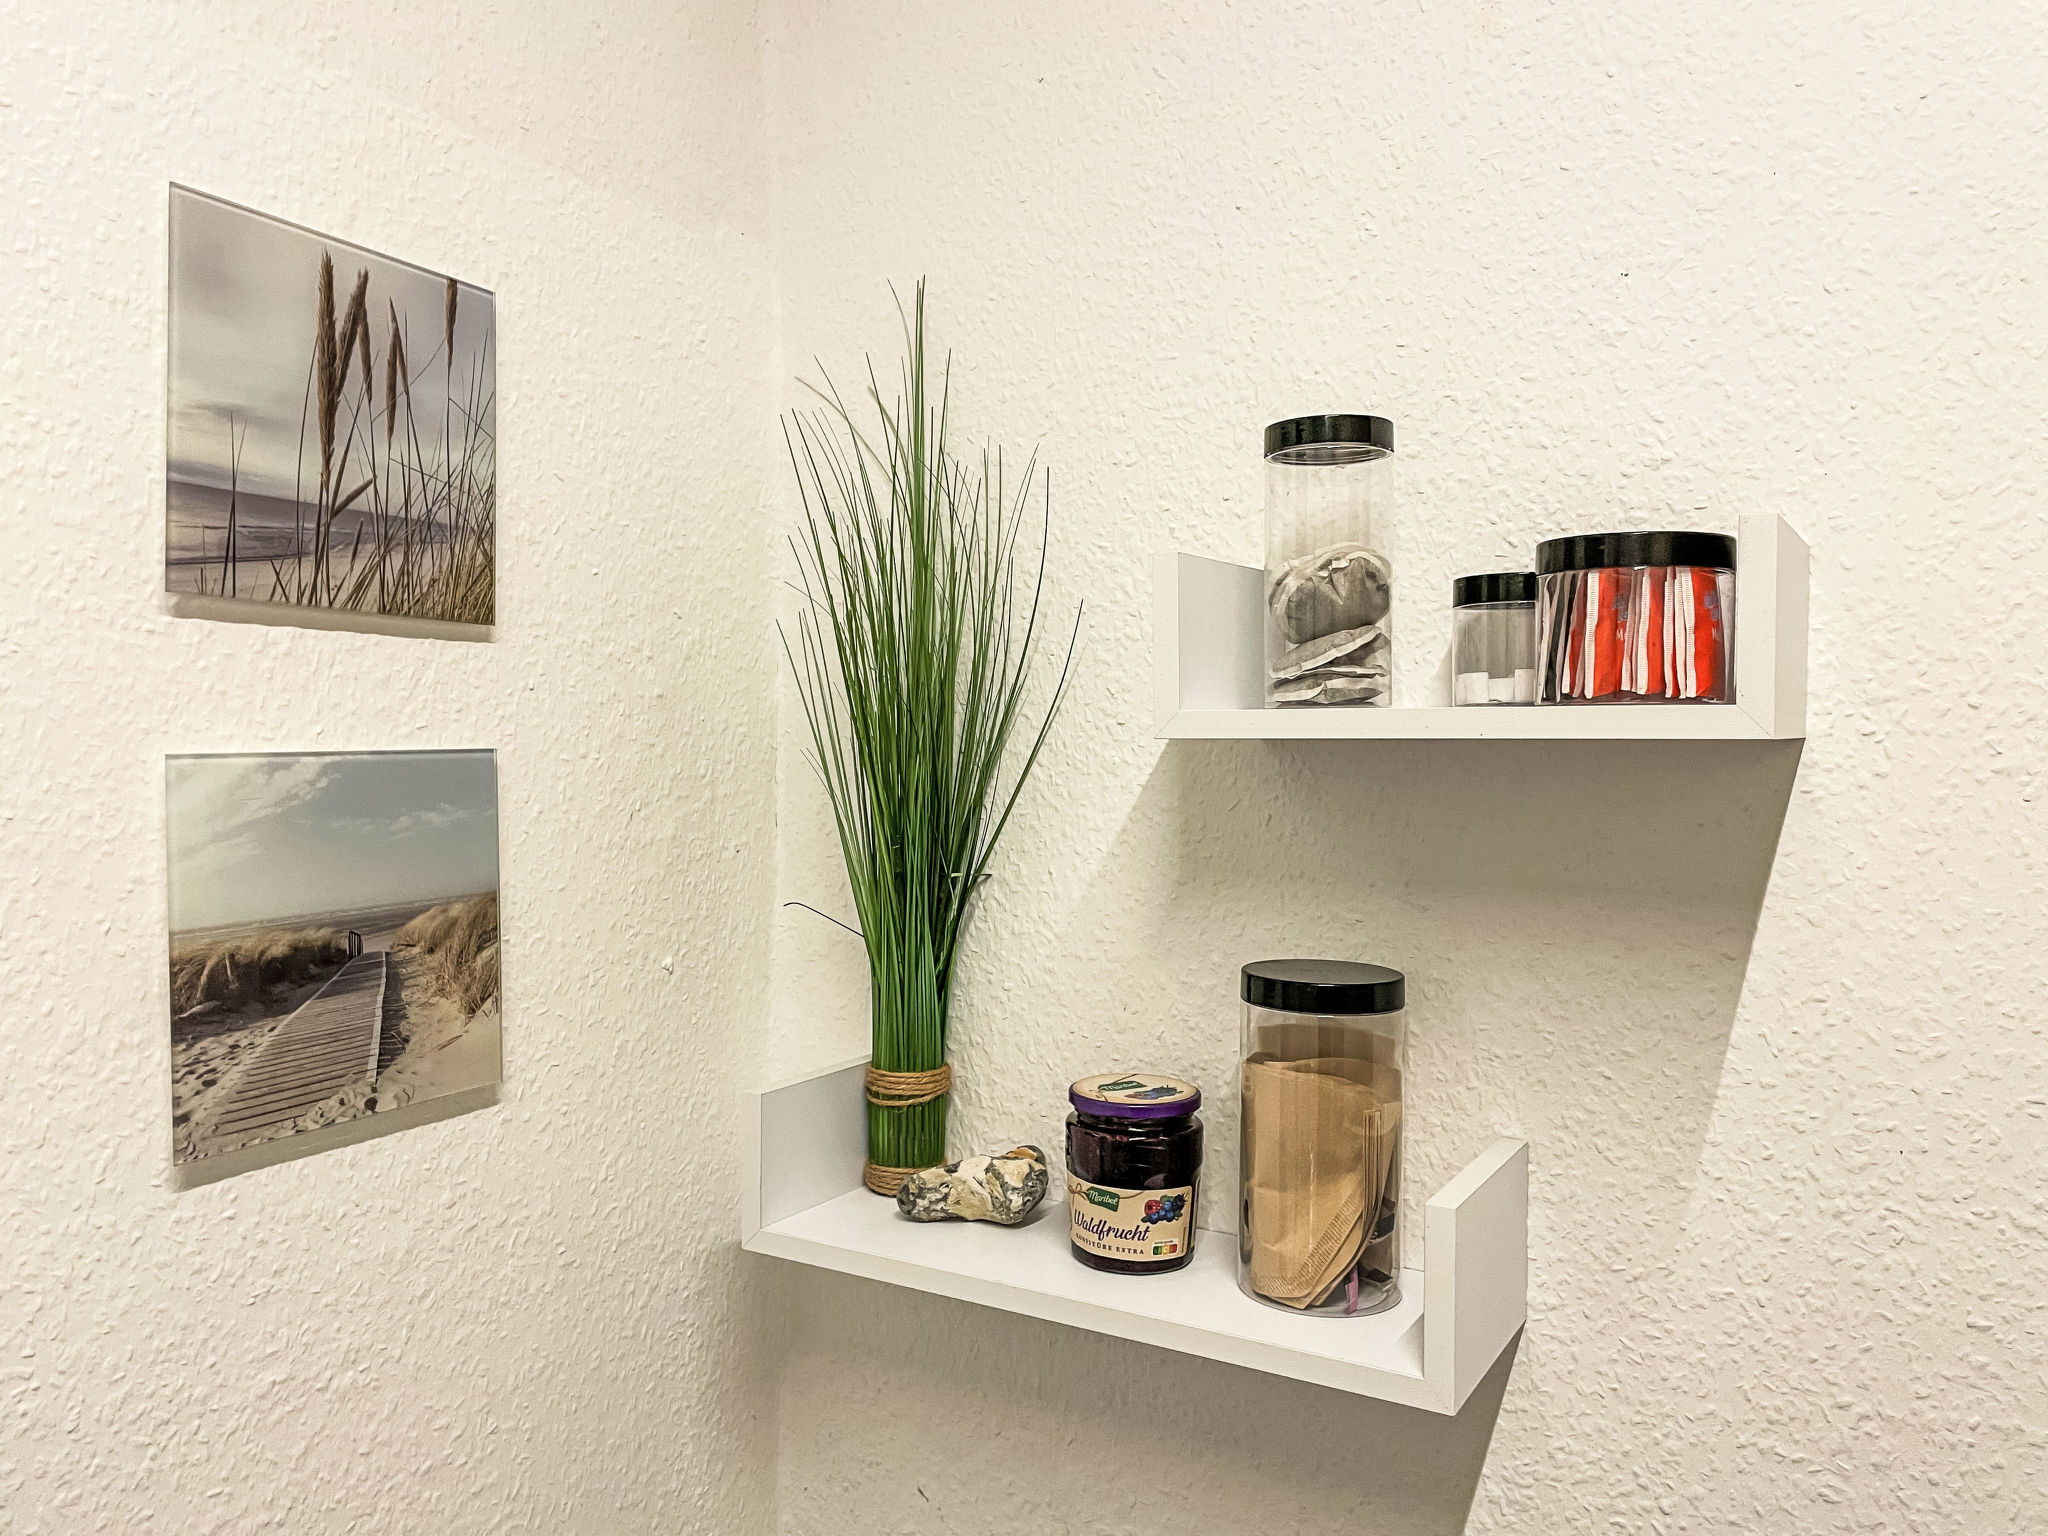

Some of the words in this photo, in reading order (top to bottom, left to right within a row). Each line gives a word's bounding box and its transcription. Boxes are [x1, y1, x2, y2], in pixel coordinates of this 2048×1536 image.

[1087, 1190, 1119, 1206] Maribel
[1074, 1208, 1151, 1241] Waldfrucht
[1116, 1246, 1145, 1255] EXTRA
